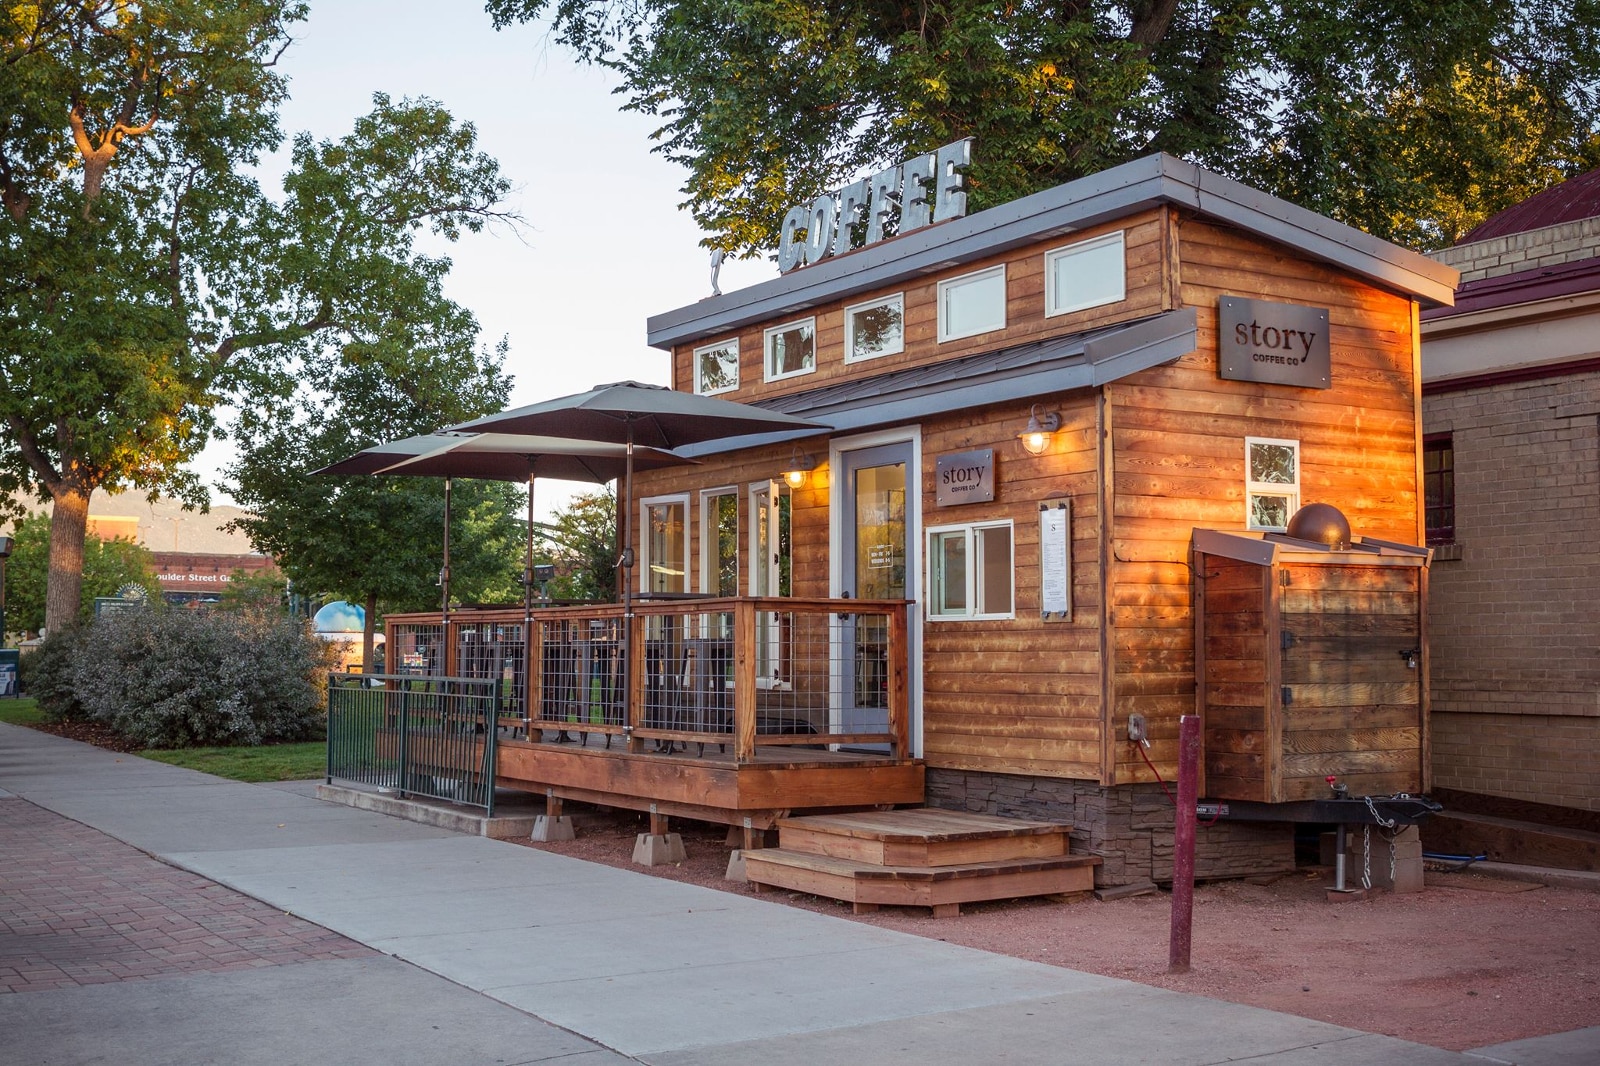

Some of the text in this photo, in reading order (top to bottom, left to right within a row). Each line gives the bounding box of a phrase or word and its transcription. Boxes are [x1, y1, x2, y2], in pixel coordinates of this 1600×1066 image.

[777, 137, 973, 274] COFFEE
[1235, 319, 1316, 363] story
[1252, 353, 1299, 366] COFFEE CO
[943, 465, 985, 487] story
[951, 485, 969, 493] COFFEE
[155, 572, 186, 581] oulder
[188, 573, 216, 582] Street
